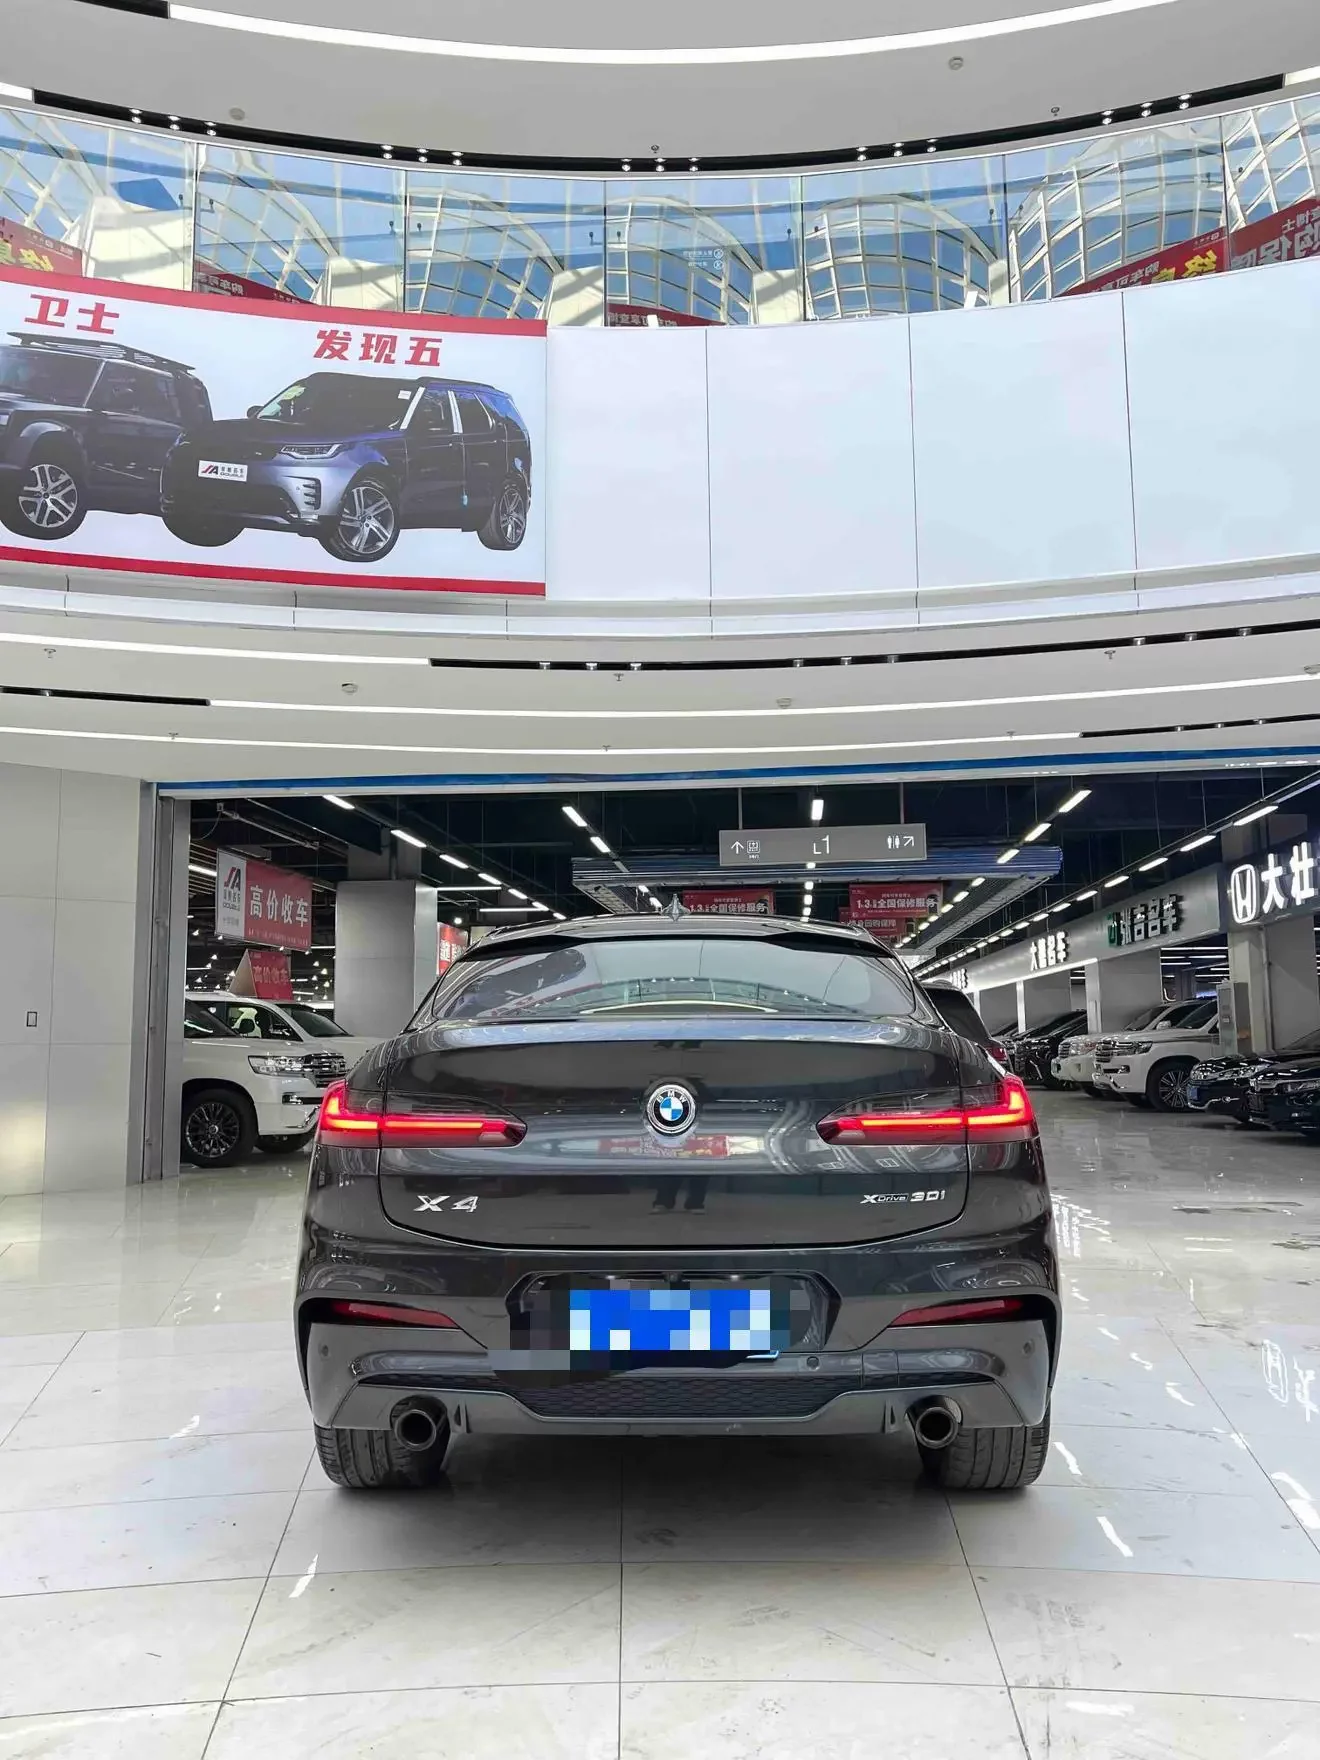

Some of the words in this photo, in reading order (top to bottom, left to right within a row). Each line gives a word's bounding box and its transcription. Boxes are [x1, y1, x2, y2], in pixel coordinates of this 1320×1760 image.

[24, 293, 120, 335] 卫士
[313, 329, 443, 367] 发现五
[813, 834, 830, 855] L1
[1261, 842, 1315, 914] 大壮
[249, 884, 309, 928] 高价收车
[413, 1195, 479, 1212] X4
